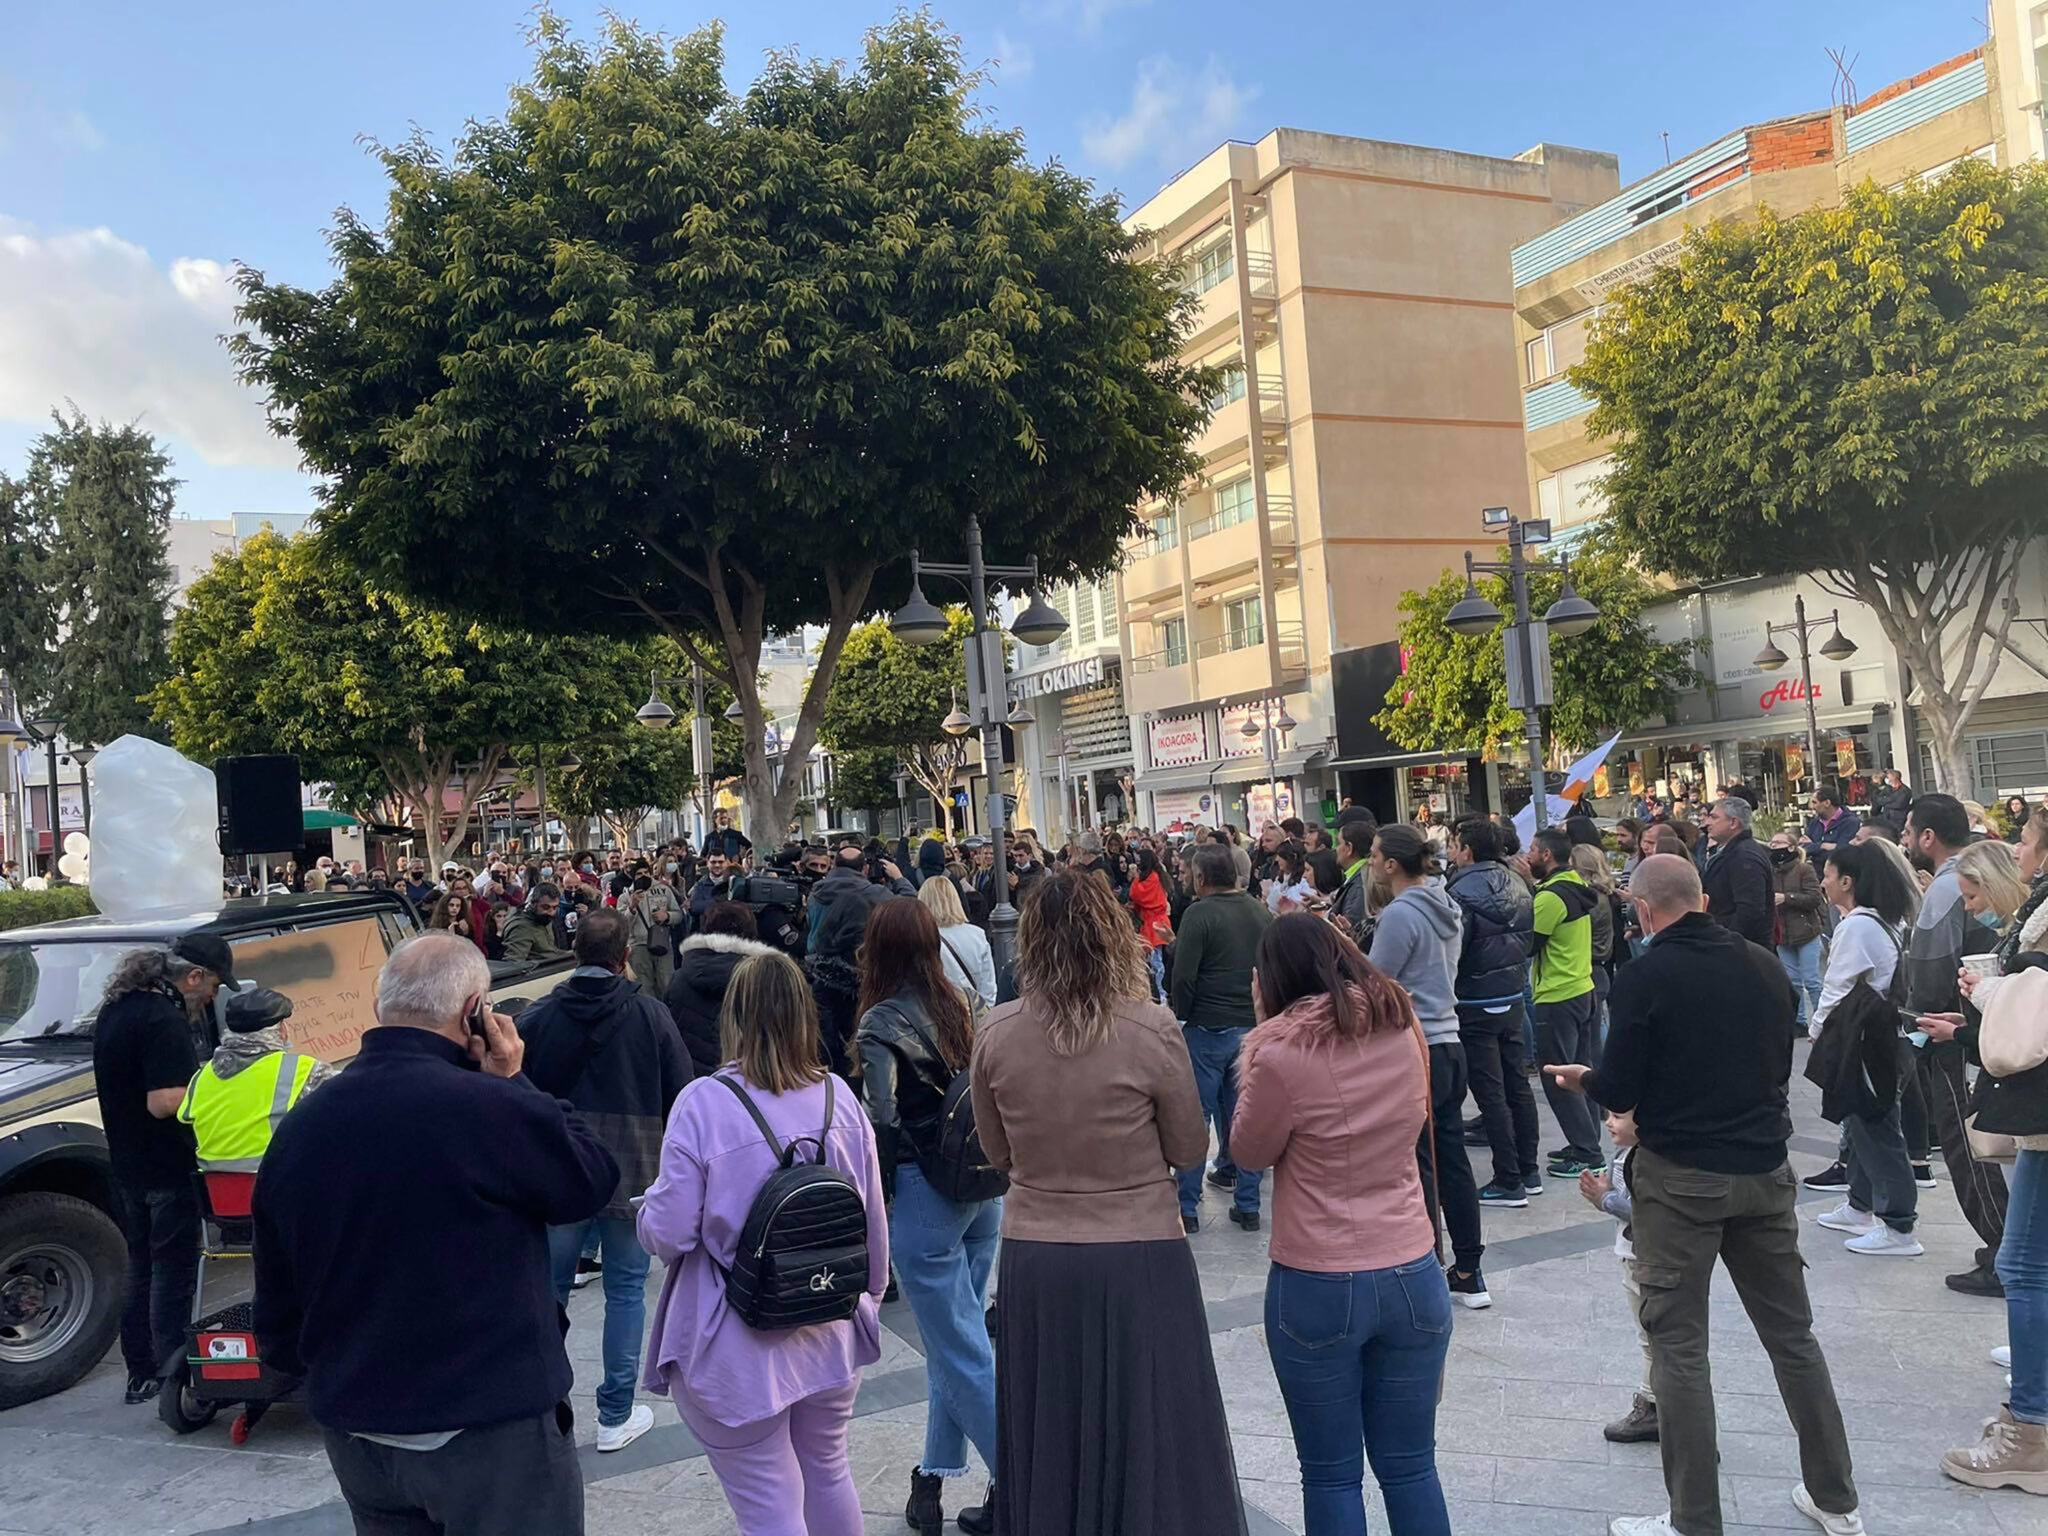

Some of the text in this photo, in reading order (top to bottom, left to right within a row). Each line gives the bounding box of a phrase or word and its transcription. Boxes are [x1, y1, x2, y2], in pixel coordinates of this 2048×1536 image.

[1594, 261, 1639, 286] CHRISTAKIS
[1647, 241, 1682, 264] KAVAZIS
[1009, 657, 1104, 700] THLOKINISI
